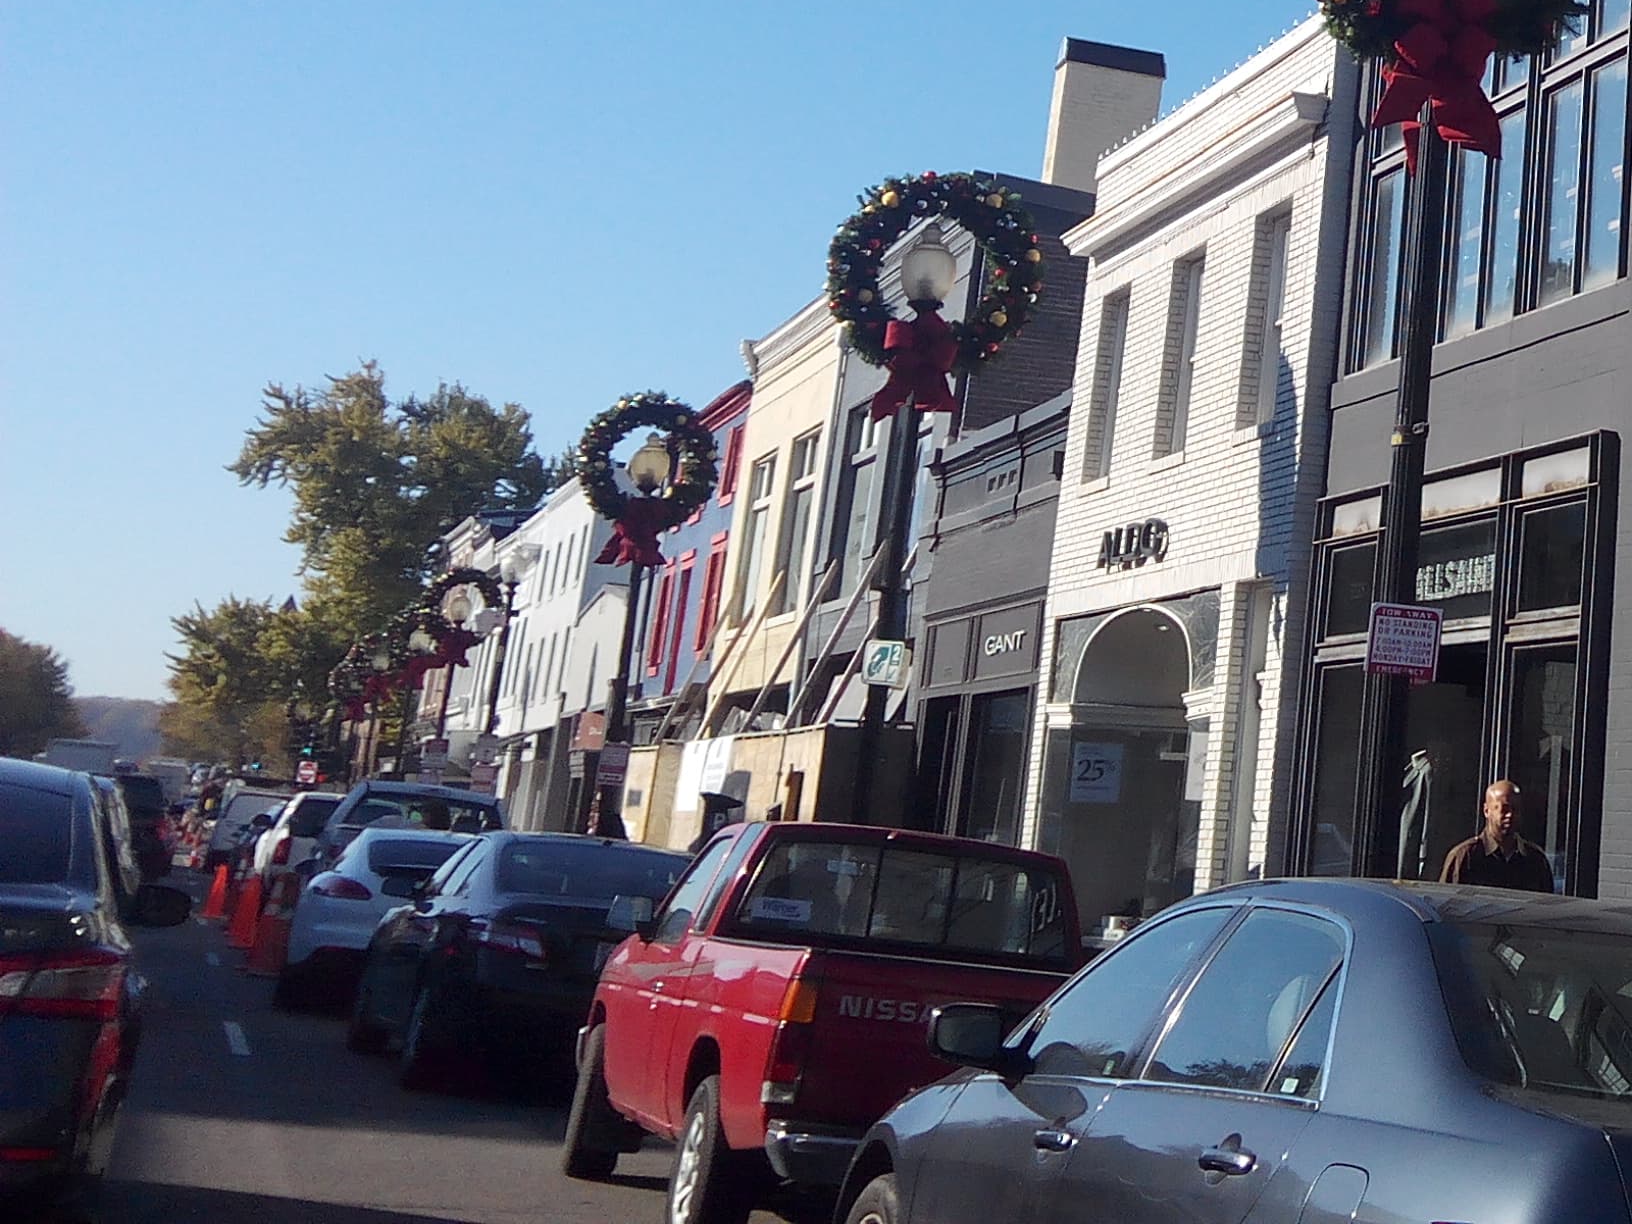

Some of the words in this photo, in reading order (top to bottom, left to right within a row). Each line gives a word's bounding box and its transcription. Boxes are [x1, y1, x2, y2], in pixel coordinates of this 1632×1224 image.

[1098, 518, 1168, 572] ALDO
[1382, 607, 1402, 616] TOW
[1406, 610, 1433, 619] AWAY
[1378, 618, 1390, 626] NO
[1393, 619, 1433, 630] STANDING
[1377, 626, 1390, 635] OR
[1393, 628, 1433, 638] PARKING
[984, 630, 1025, 656] GANT
[892, 645, 901, 661] 2
